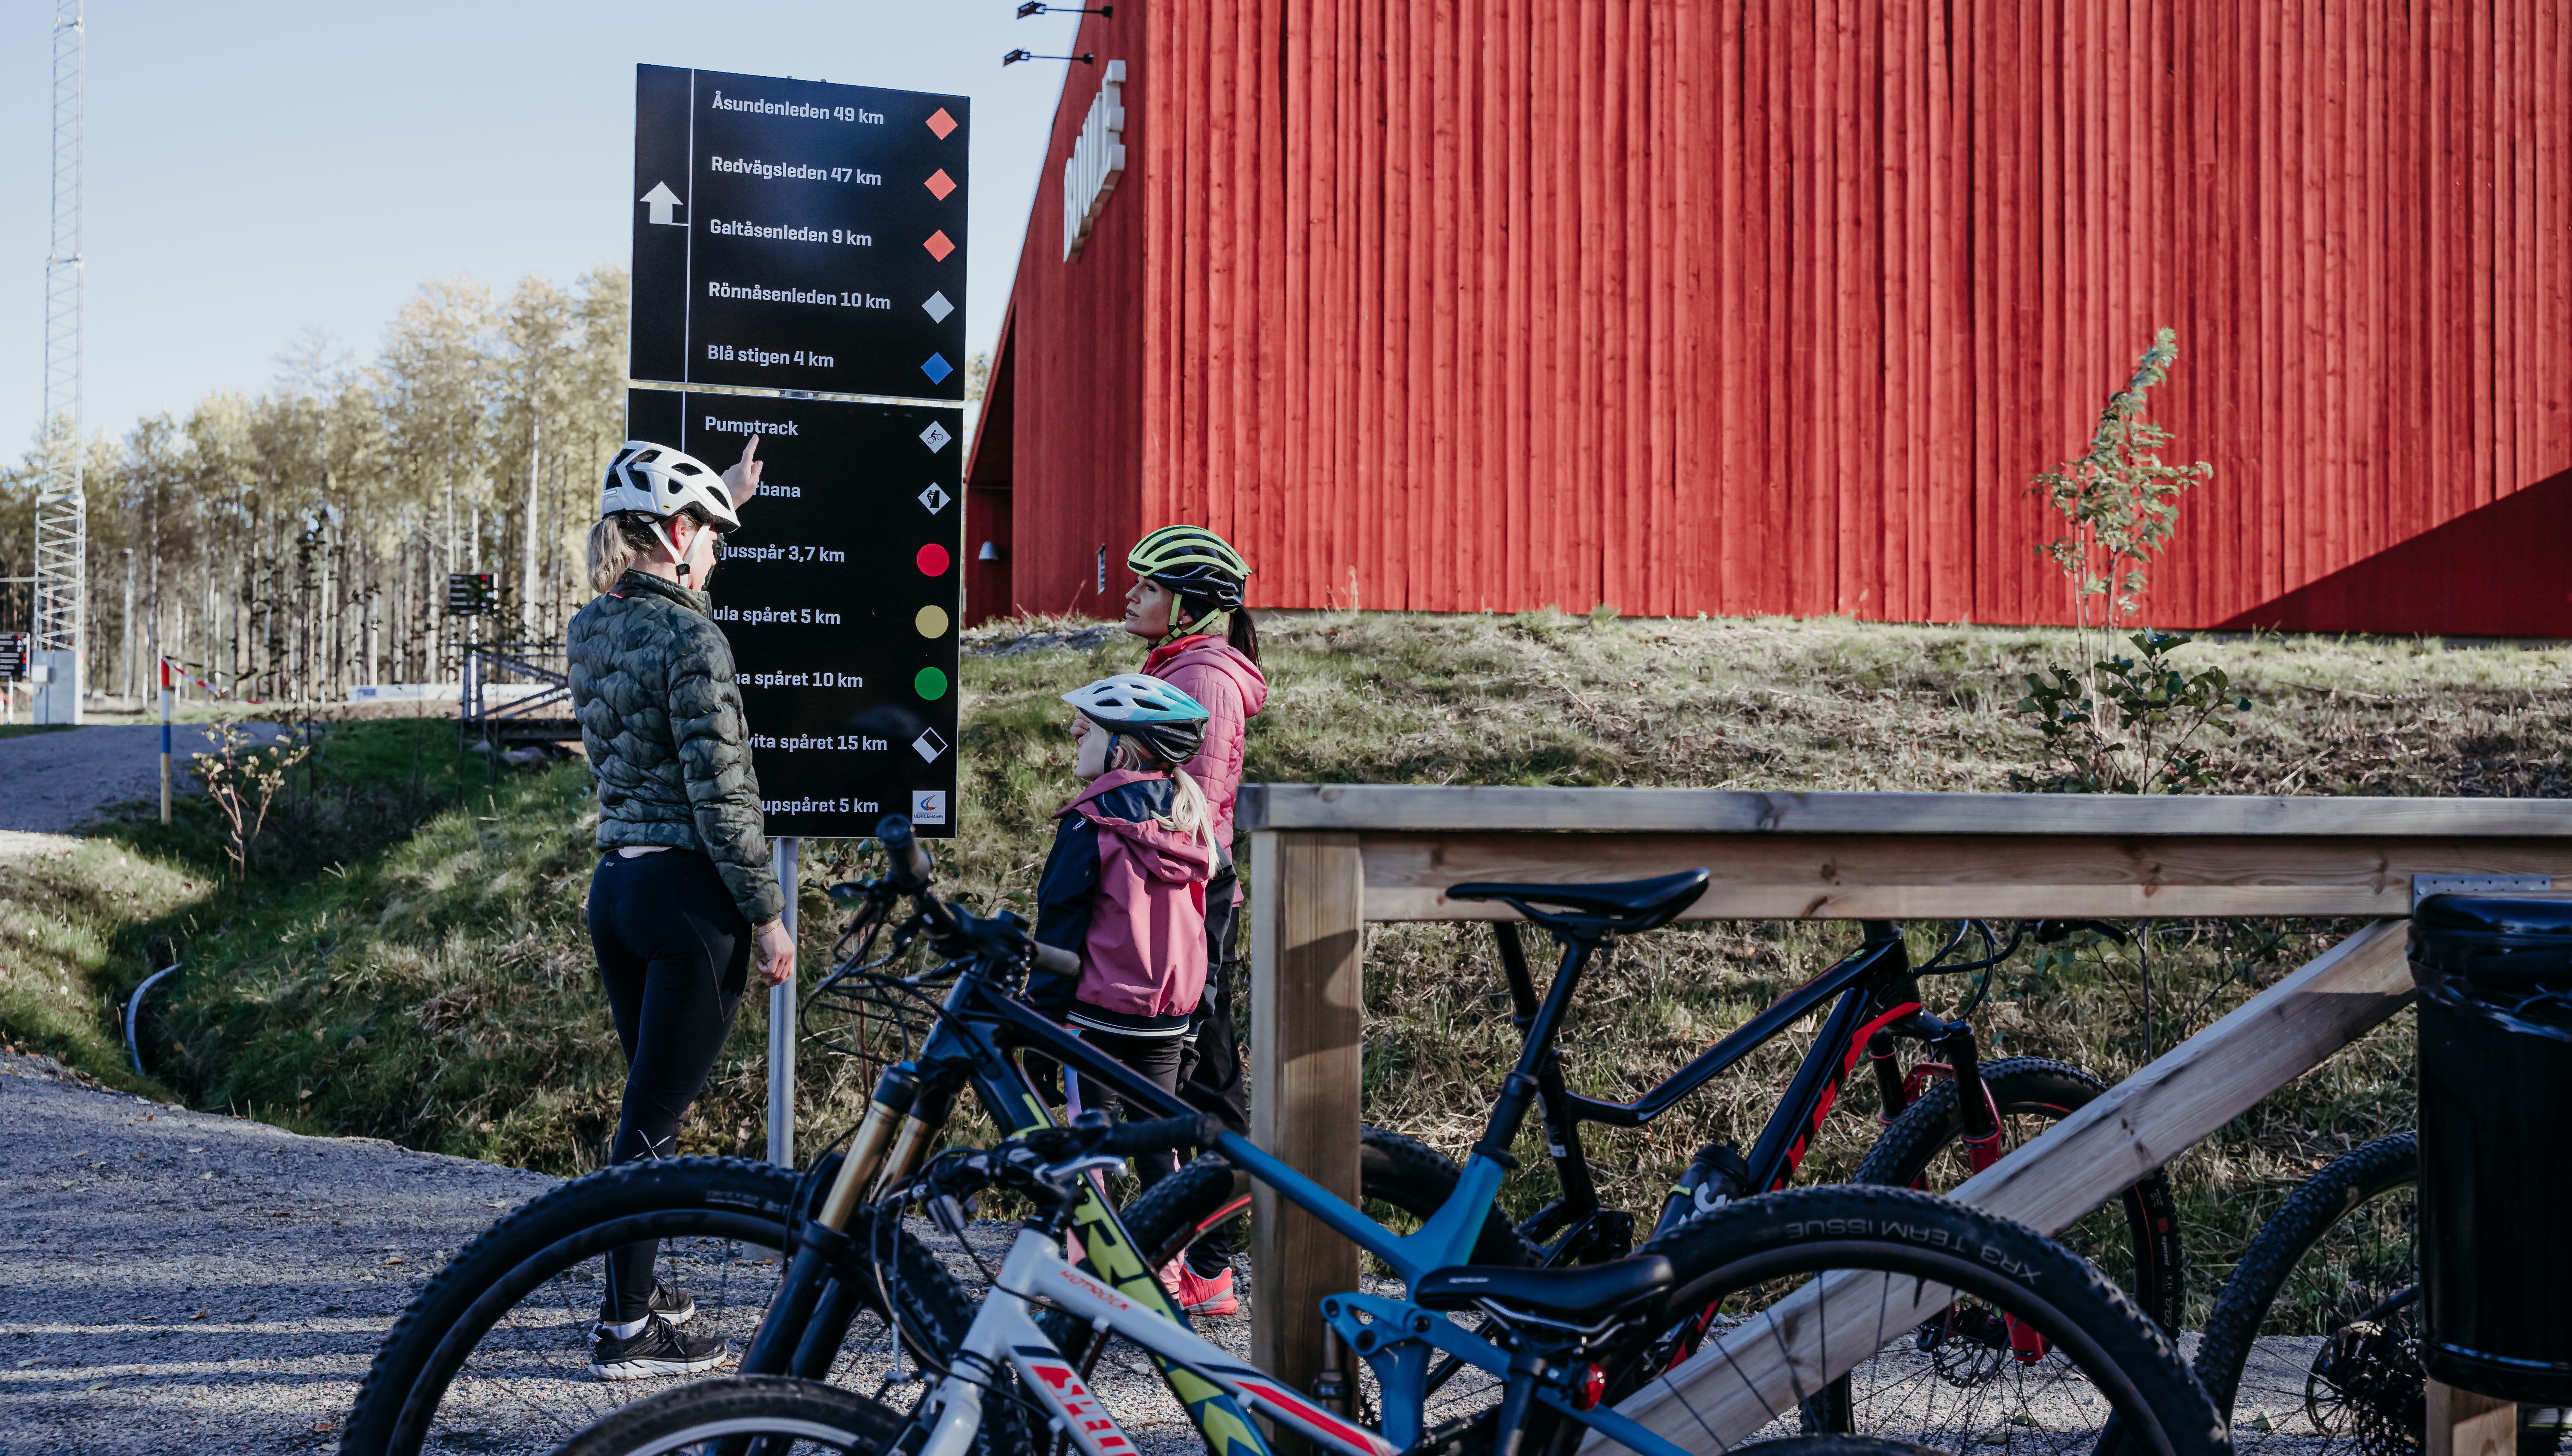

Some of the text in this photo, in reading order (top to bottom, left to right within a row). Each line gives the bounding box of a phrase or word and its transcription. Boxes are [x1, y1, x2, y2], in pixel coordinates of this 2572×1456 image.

[712, 90, 884, 125] Åsundenleden 49 km
[712, 156, 881, 186] Redvägsleden 47 km
[710, 219, 872, 246] Galtåsenleden 9 km
[709, 282, 891, 309] Rönnåsenleden 10 km
[708, 345, 834, 367] Blå stigen 4 km
[705, 416, 798, 436] Pumptrack
[753, 481, 801, 498] rbana
[719, 543, 844, 562] jusspår 3,7 km
[713, 606, 840, 625] ula spåret 5 km
[735, 670, 862, 689] na spåret 10 km
[748, 733, 887, 753] vita spåret 15 km
[761, 797, 878, 816] upspåret 5 km
[1786, 1218, 2042, 1285] XR3 TEAM ISSUE
